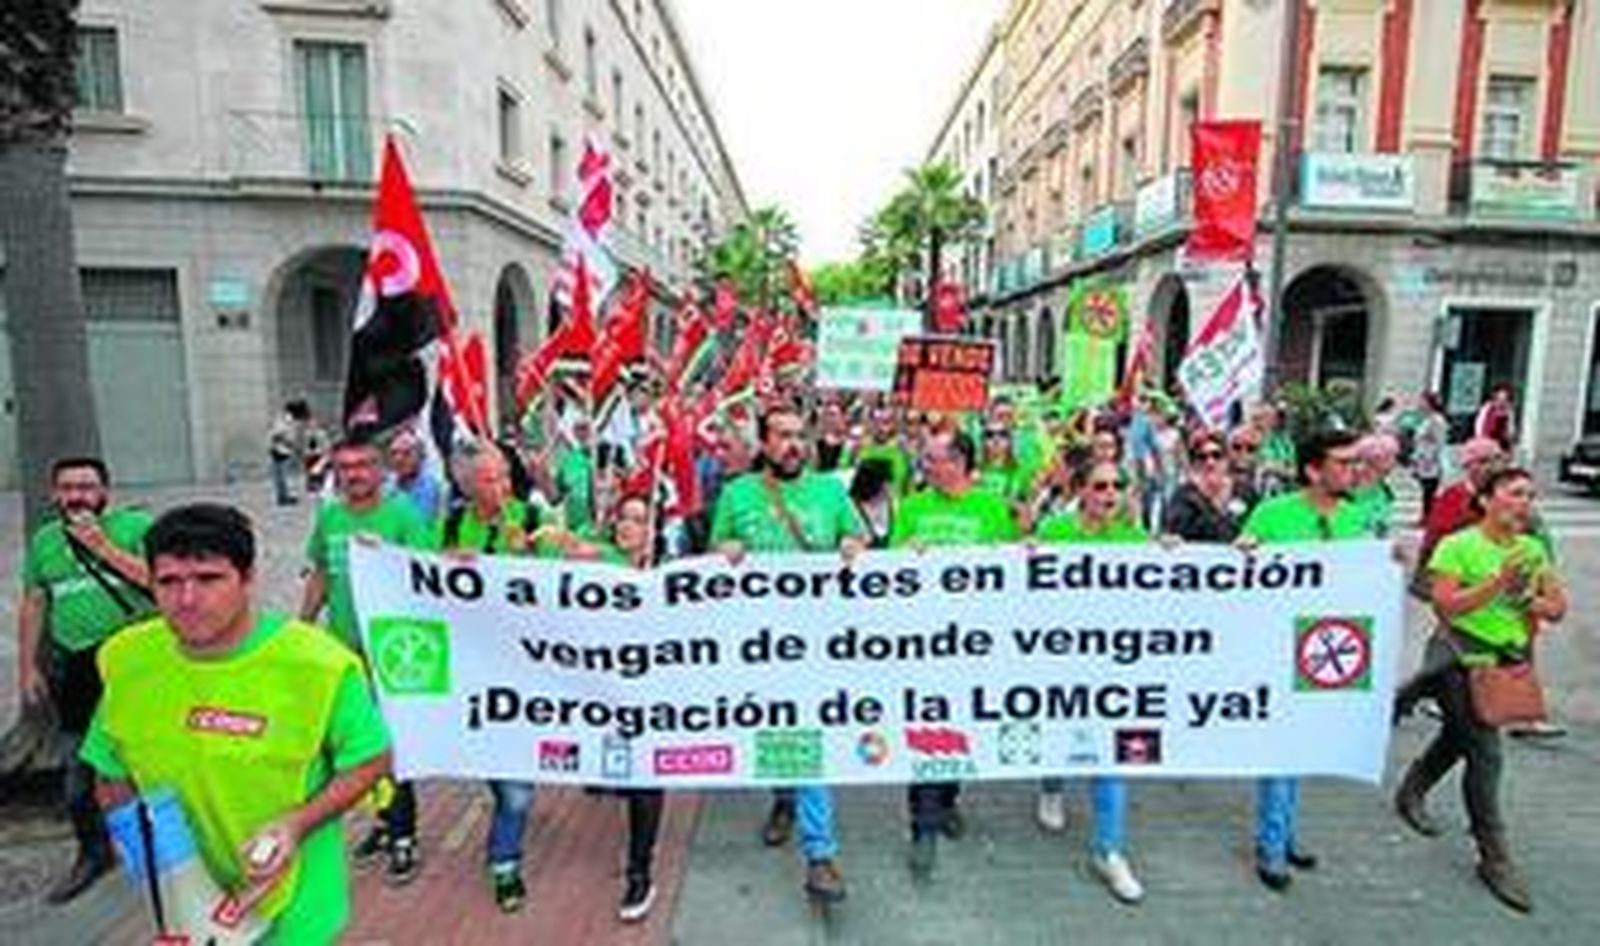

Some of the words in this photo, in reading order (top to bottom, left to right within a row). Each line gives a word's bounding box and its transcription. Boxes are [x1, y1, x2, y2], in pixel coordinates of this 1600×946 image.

[410, 561, 484, 601] NO
[508, 578, 537, 605] a
[559, 573, 642, 610] los
[665, 567, 921, 605] Recortes
[941, 565, 1004, 593] en
[1028, 554, 1323, 591] Educación
[521, 636, 719, 678] vengan
[740, 628, 806, 663] de
[827, 623, 993, 661] donde
[1014, 628, 1212, 665] vengan
[467, 686, 798, 741] ¡Derogación
[819, 690, 882, 725] de
[904, 687, 950, 722] la
[972, 685, 1167, 721] LOMCE
[1188, 686, 1270, 728] ya!
